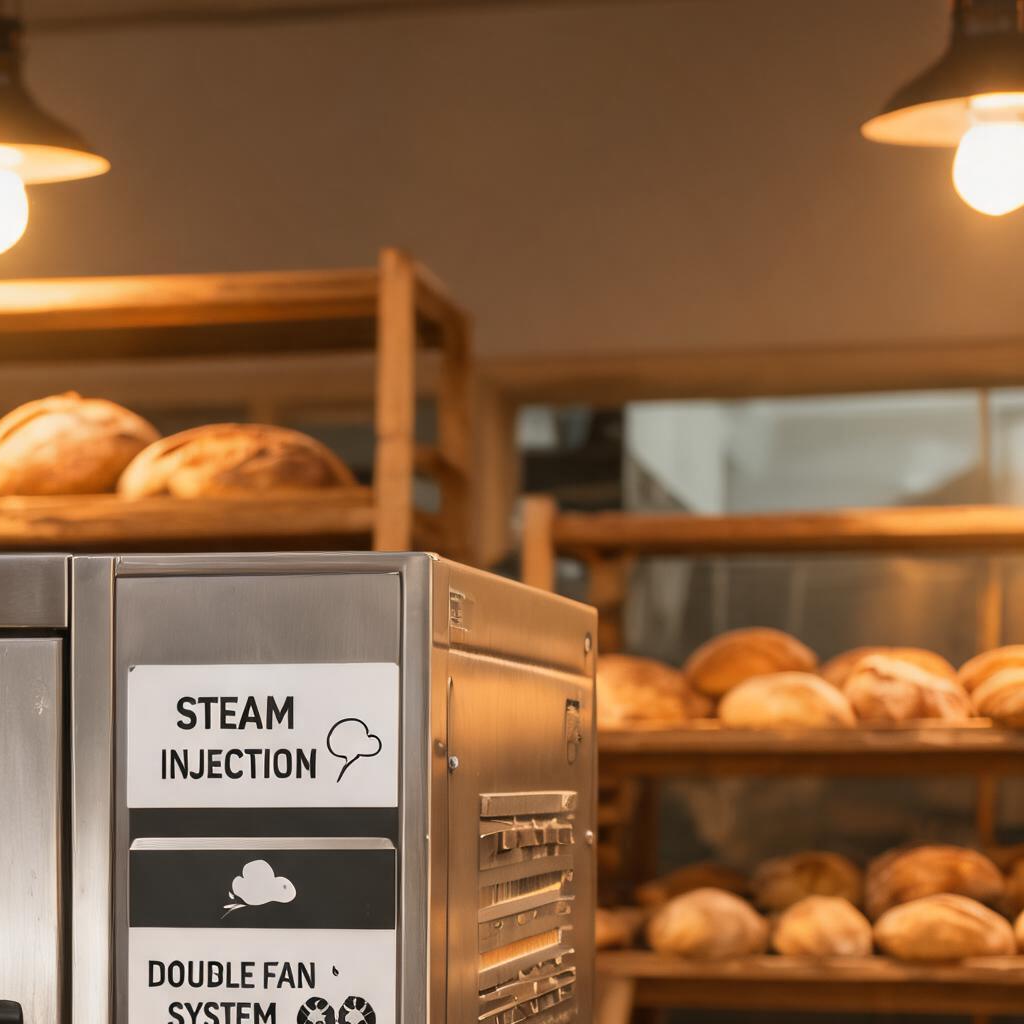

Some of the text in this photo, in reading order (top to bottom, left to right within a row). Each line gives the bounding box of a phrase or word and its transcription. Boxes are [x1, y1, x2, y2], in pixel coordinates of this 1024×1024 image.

[176, 695, 294, 731] STEAM
[161, 748, 317, 780] INJECTION
[148, 960, 316, 990] DOUBLE FAN
